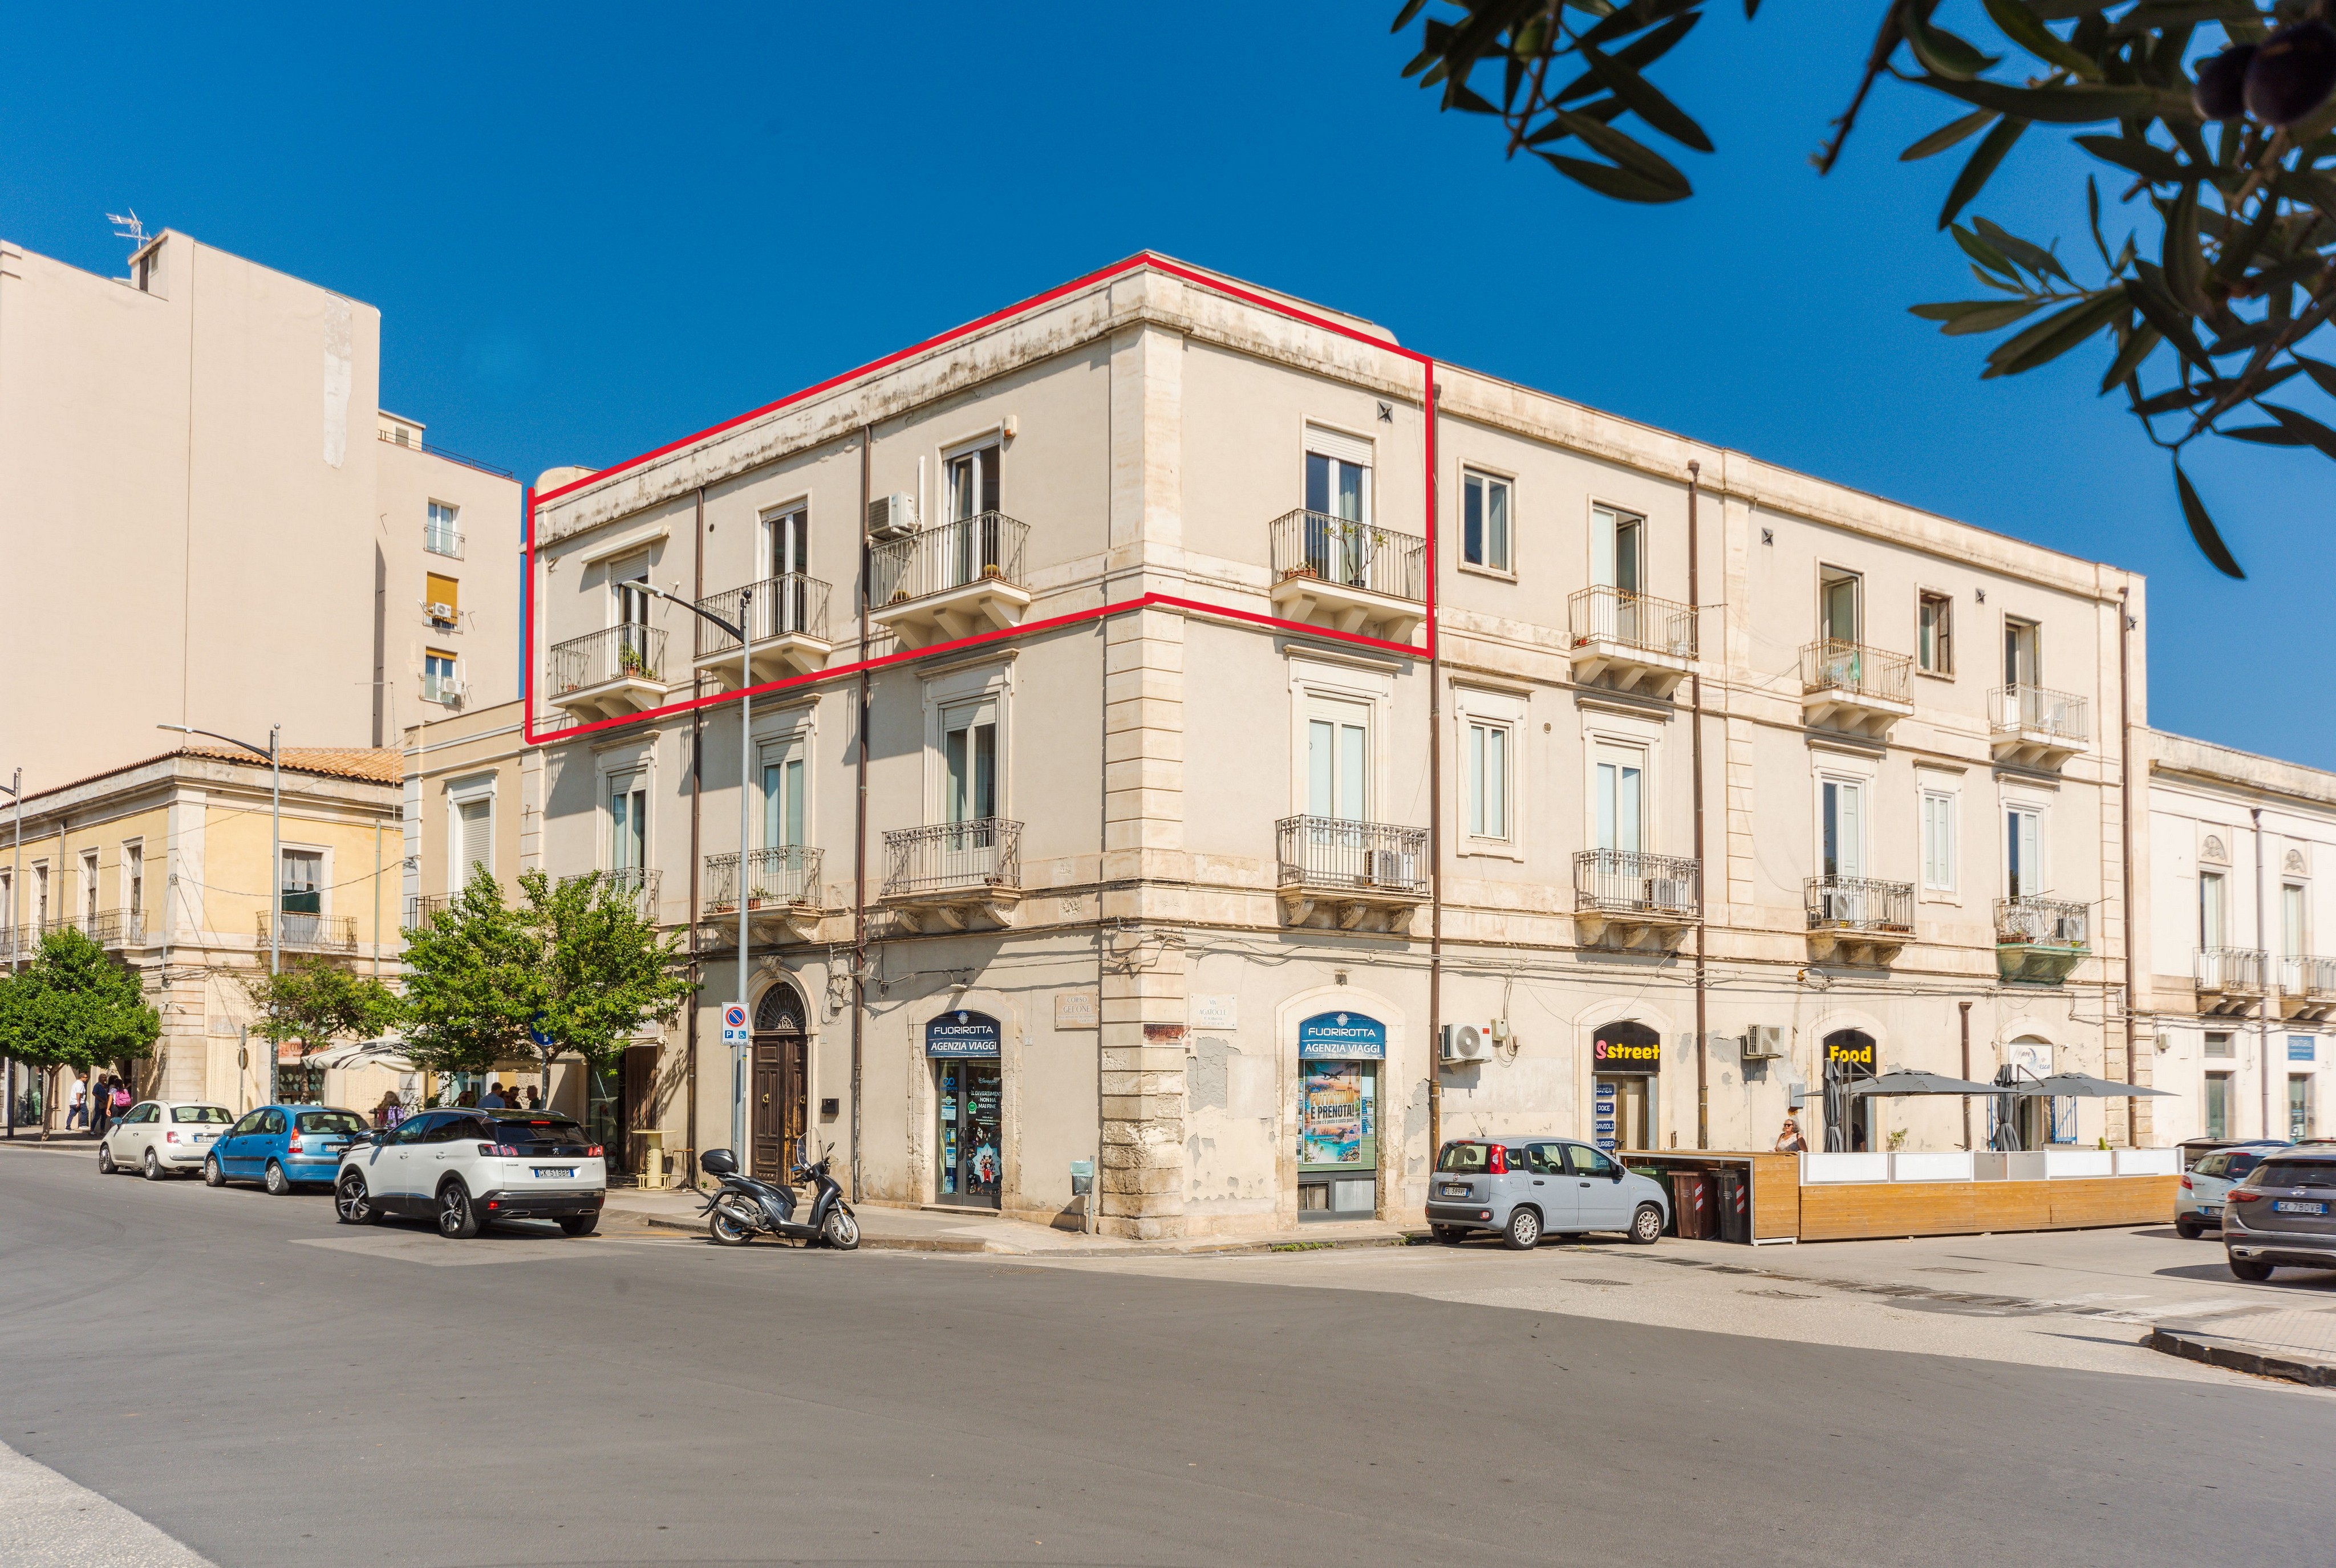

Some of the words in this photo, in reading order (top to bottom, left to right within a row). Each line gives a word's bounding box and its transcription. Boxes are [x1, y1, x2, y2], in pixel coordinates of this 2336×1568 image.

[934, 1026, 993, 1035] FUORIROTTA
[1308, 1027, 1376, 1037] FUORIROTTA
[931, 1041, 967, 1051] AGENZIA
[968, 1041, 997, 1050] VIAGGI
[1304, 1043, 1347, 1053] AGENZIA
[1348, 1044, 1380, 1053] VIAGGI
[1828, 1044, 1872, 1064] Food
[1311, 1107, 1316, 1119] E
[1317, 1104, 1354, 1119] PRENOTA!
